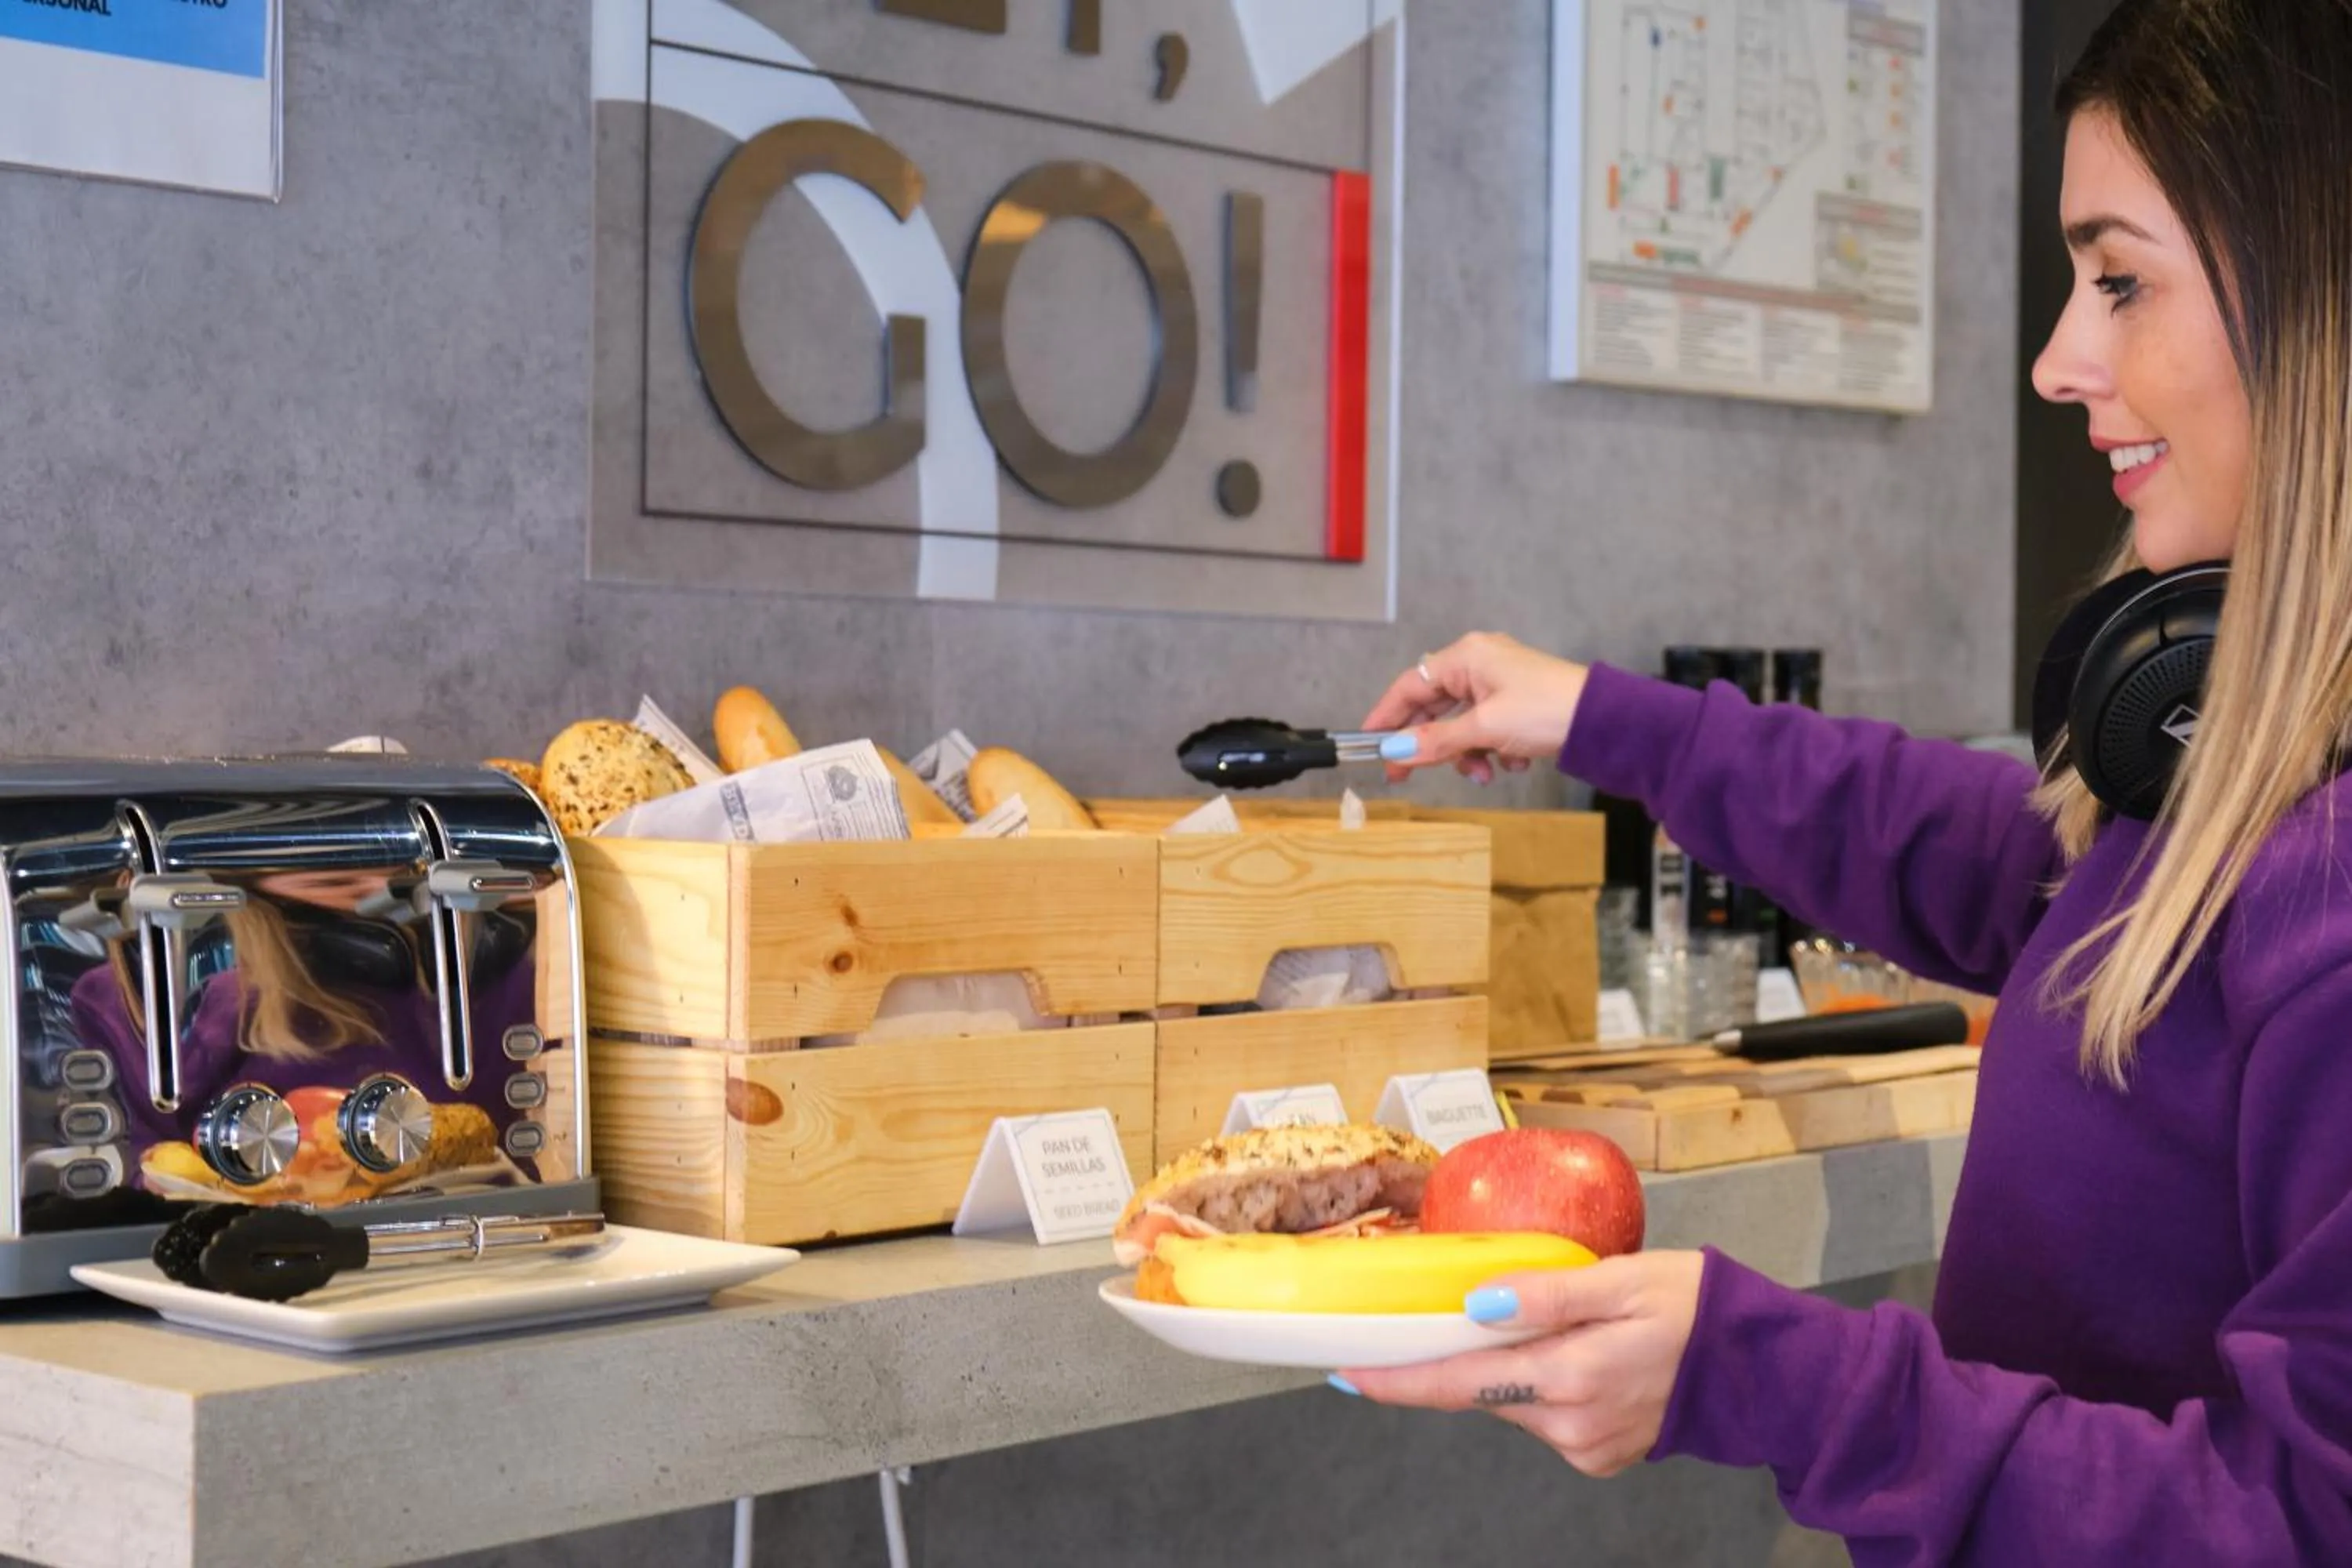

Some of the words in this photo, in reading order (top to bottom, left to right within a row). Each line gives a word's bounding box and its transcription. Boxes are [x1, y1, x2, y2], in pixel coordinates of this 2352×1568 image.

[688, 117, 1264, 518] GO!
[1041, 1139, 1071, 1155] PAN
[1071, 1135, 1090, 1154] DE
[1040, 1156, 1107, 1178] SEMILLAS
